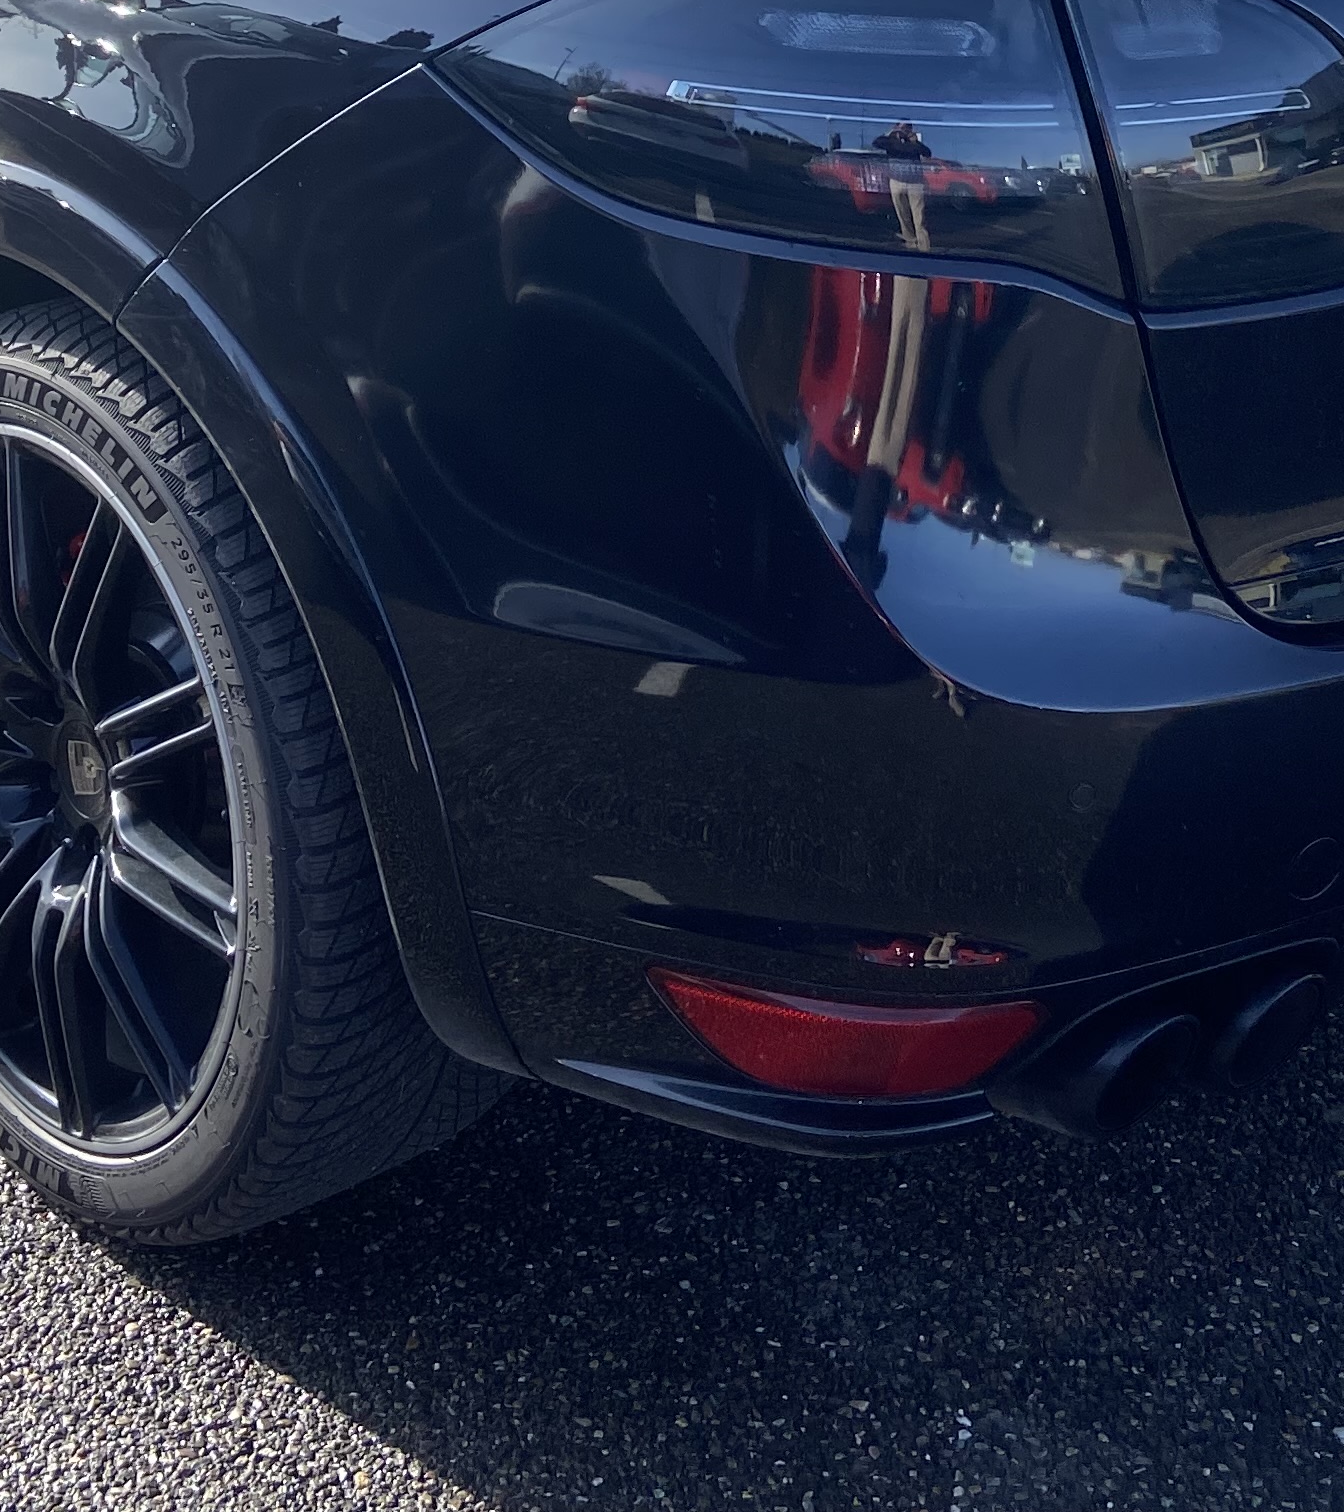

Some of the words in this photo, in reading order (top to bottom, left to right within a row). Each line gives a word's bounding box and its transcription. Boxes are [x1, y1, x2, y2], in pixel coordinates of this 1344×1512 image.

[5, 372, 157, 510] MICHELIN
[170, 537, 214, 614] 295/35
[210, 623, 223, 637] R
[218, 648, 236, 673] 21
